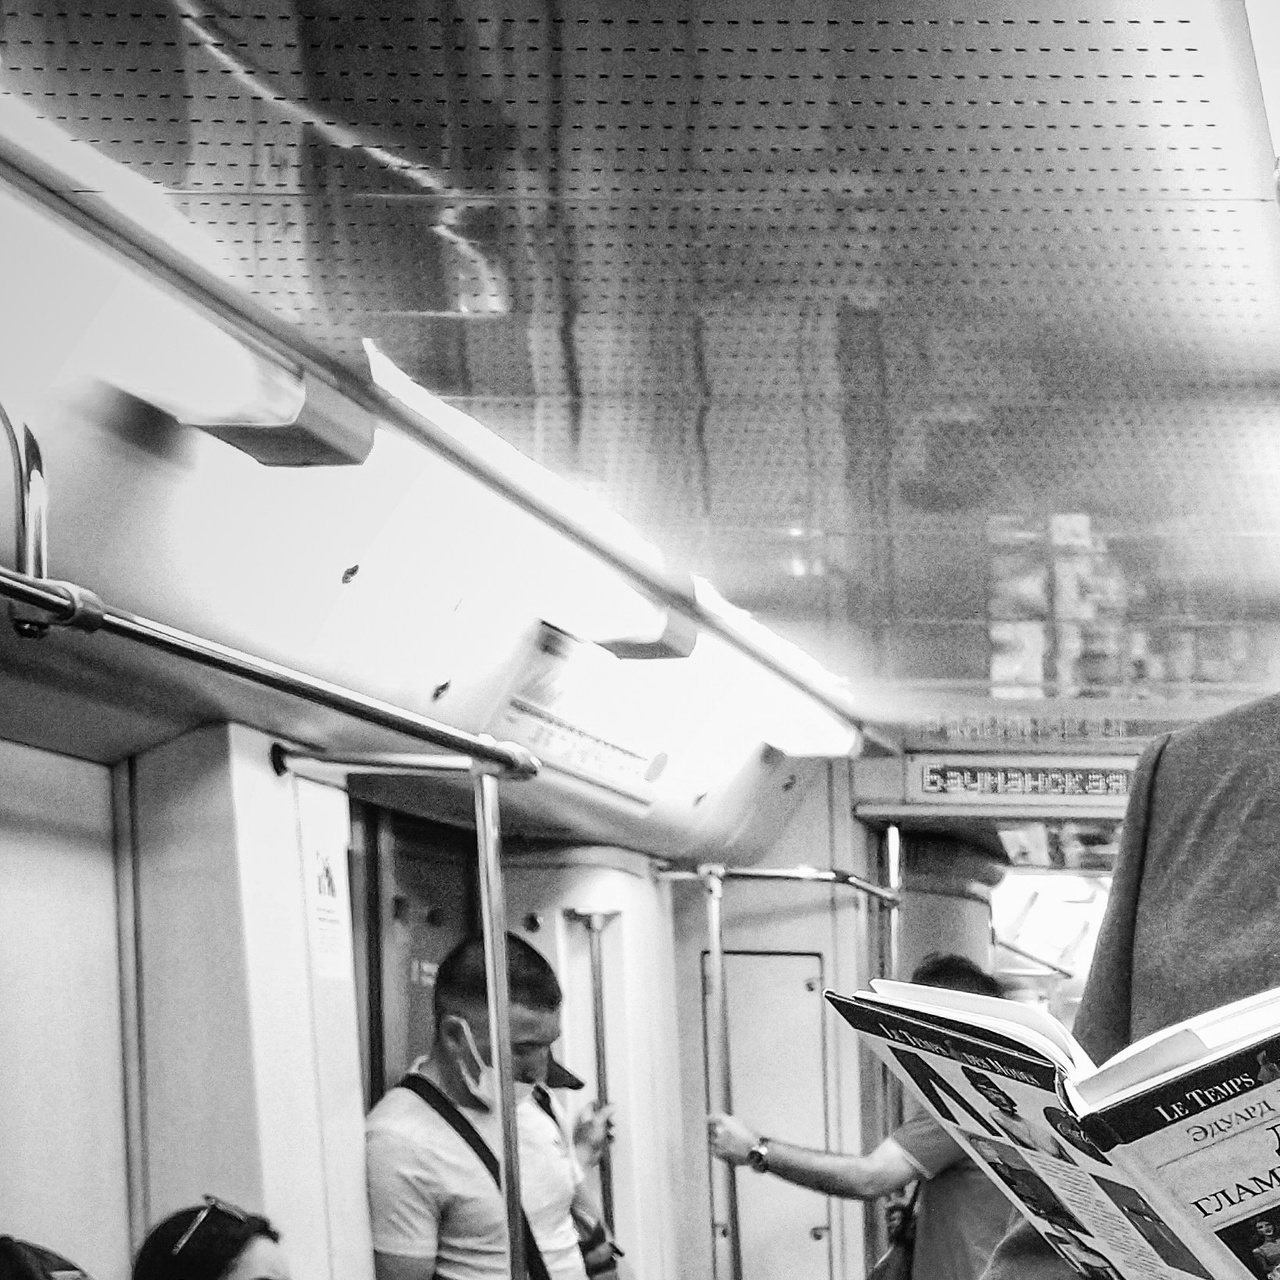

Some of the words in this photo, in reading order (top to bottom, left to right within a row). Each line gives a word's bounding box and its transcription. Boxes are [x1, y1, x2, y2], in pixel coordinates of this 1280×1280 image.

[1154, 1102, 1189, 1123] LE
[1185, 1073, 1256, 1108] TEMPS
[1186, 1099, 1275, 1142] ЭДУАРД
